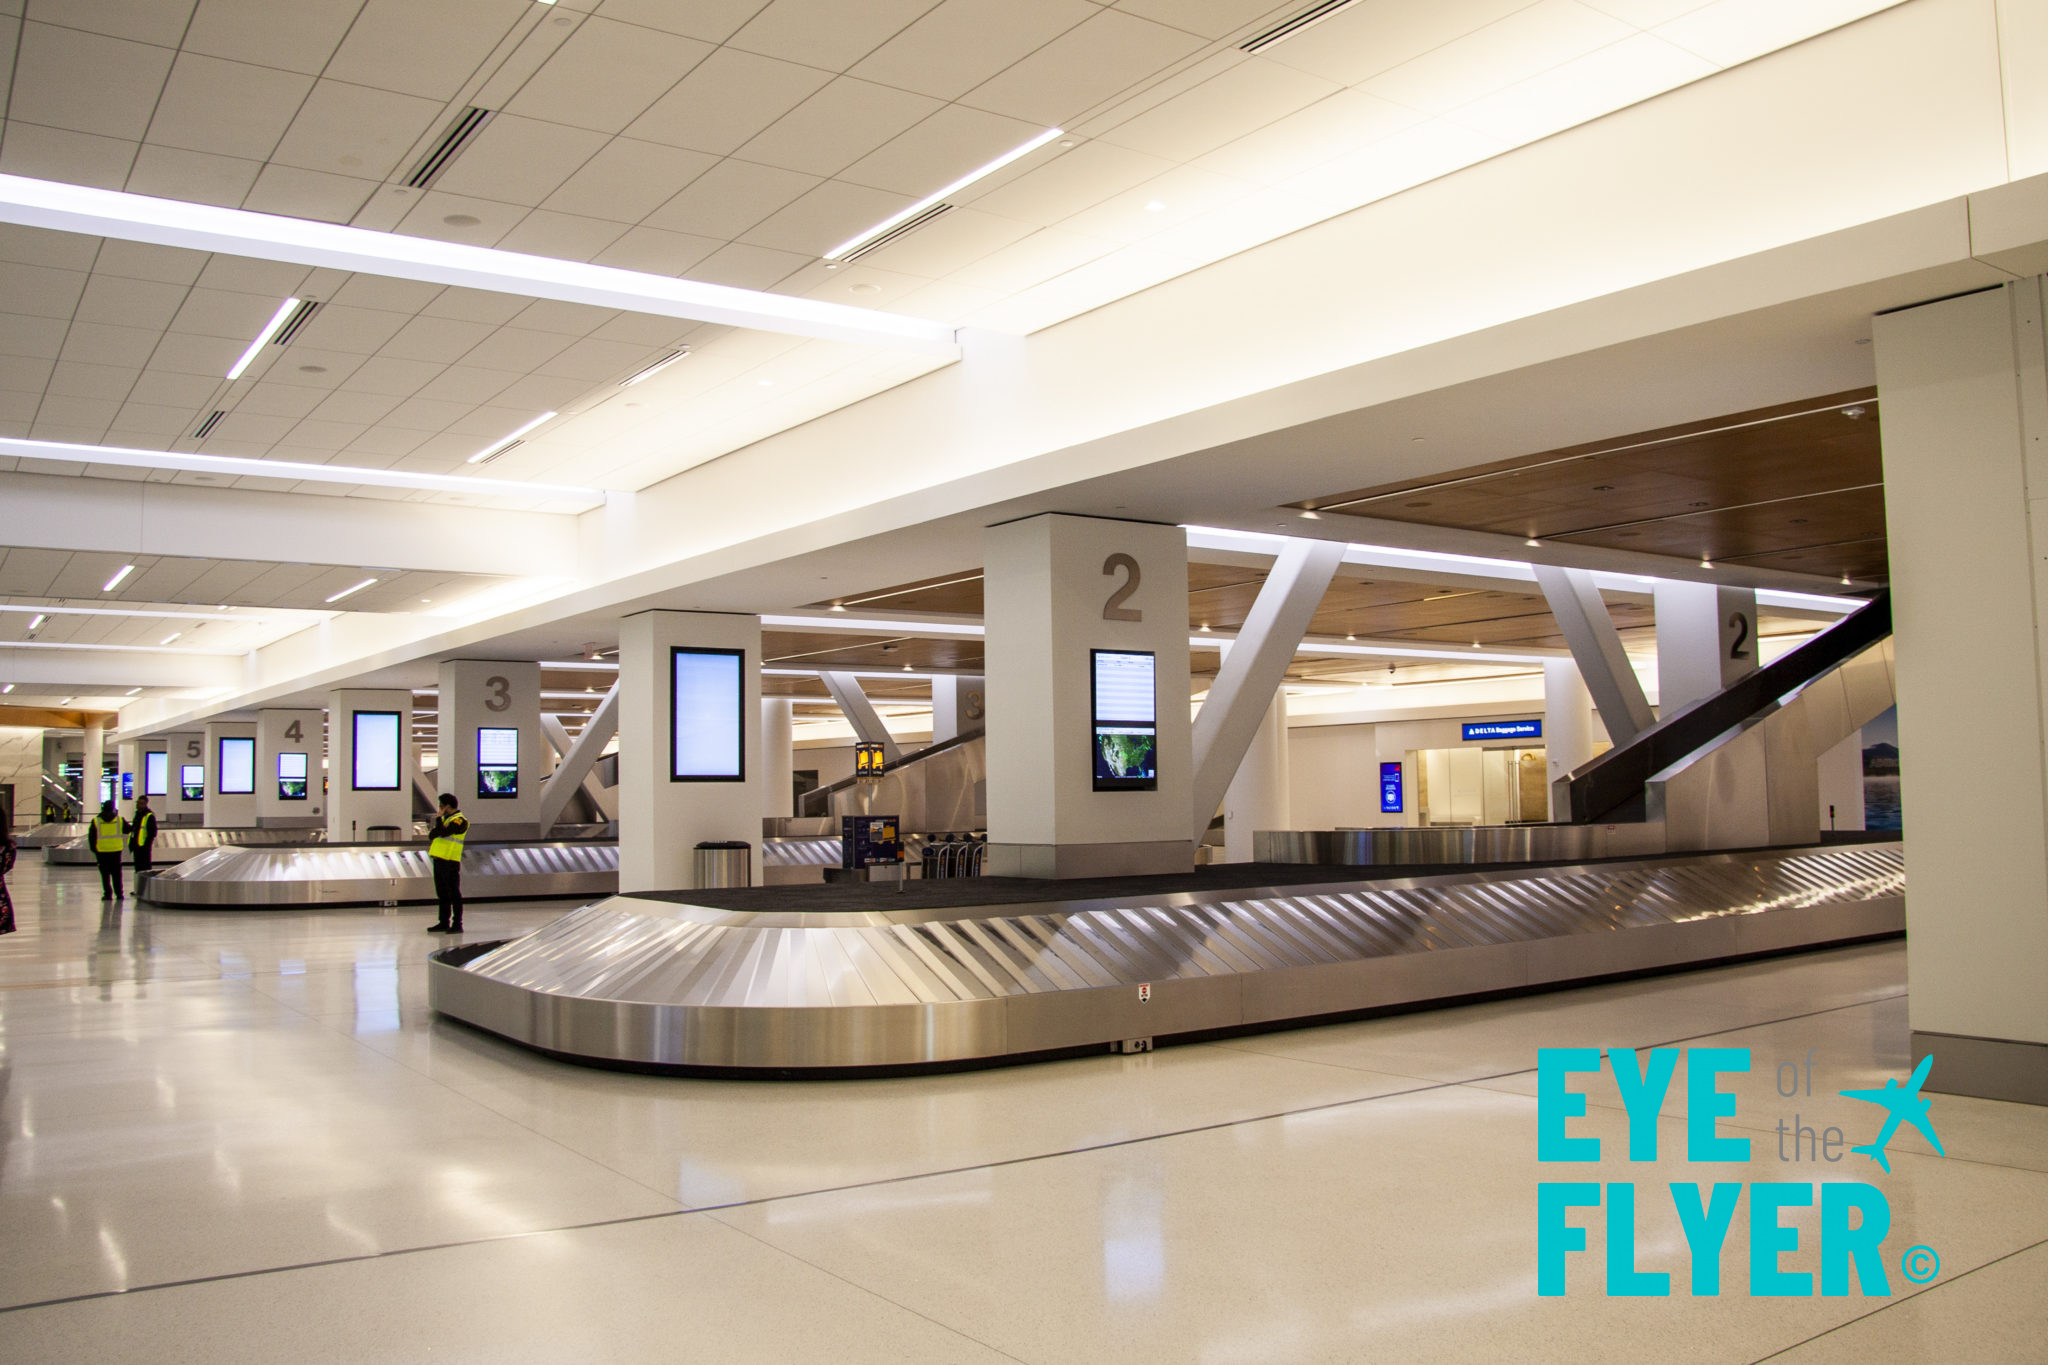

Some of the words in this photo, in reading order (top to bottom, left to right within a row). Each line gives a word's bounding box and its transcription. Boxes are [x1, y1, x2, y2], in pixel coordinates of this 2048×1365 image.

[1103, 552, 1142, 622] 2
[1728, 611, 1750, 660] 2
[485, 675, 512, 712] 3
[284, 720, 304, 743] 4
[1474, 727, 1496, 735] DELTA
[187, 741, 201, 758] 5
